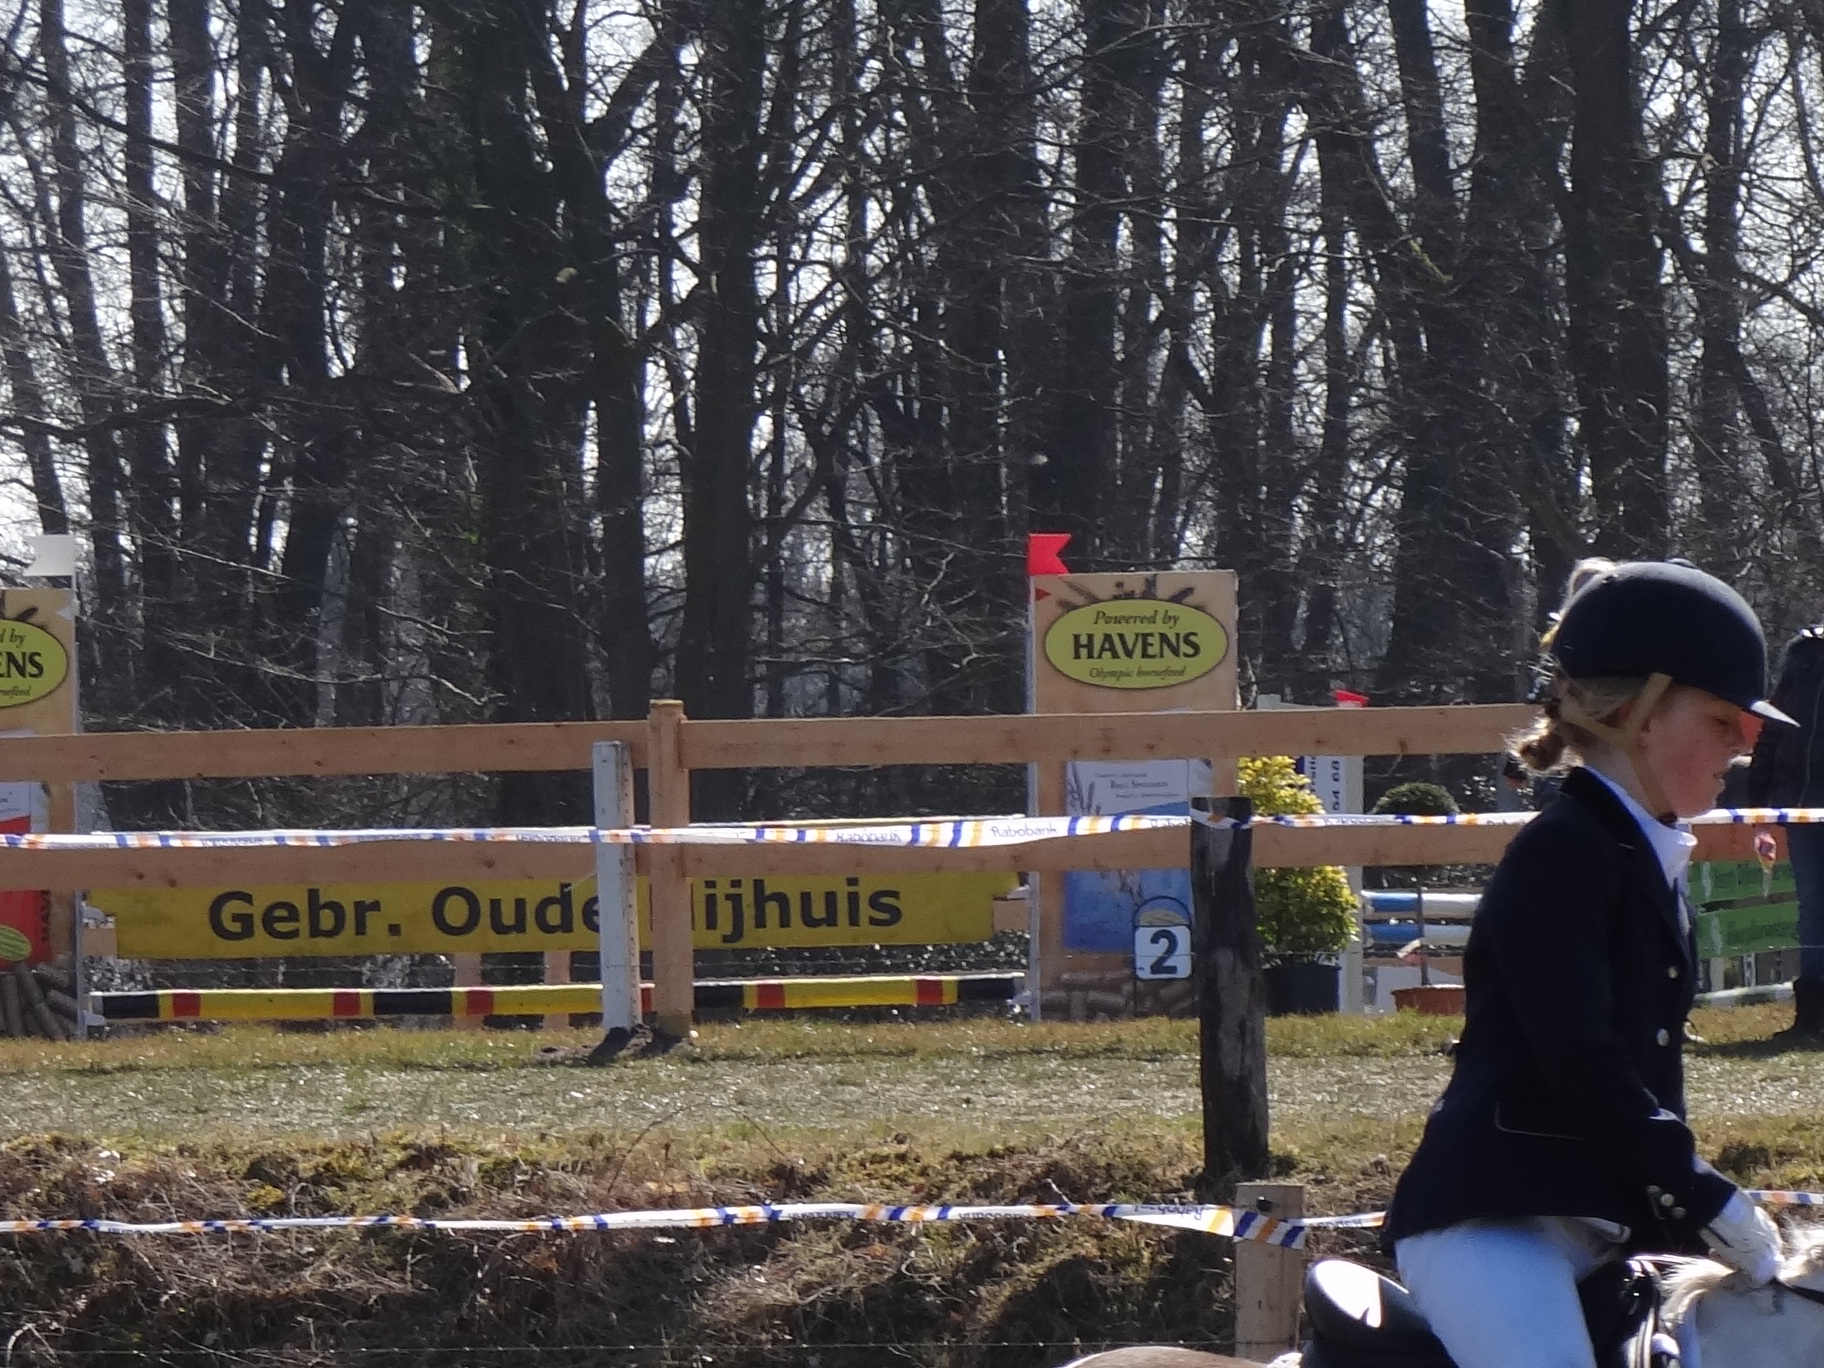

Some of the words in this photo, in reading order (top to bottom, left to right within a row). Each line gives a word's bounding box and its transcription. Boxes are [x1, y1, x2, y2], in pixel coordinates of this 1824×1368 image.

[1093, 610, 1159, 625] Powered
[1162, 610, 1181, 629] by
[1072, 632, 1201, 660] HAVENS
[991, 822, 1057, 837] Rabobank
[209, 888, 401, 941] Gebr.
[690, 877, 903, 943] ijhuis
[1150, 929, 1178, 974] 2
